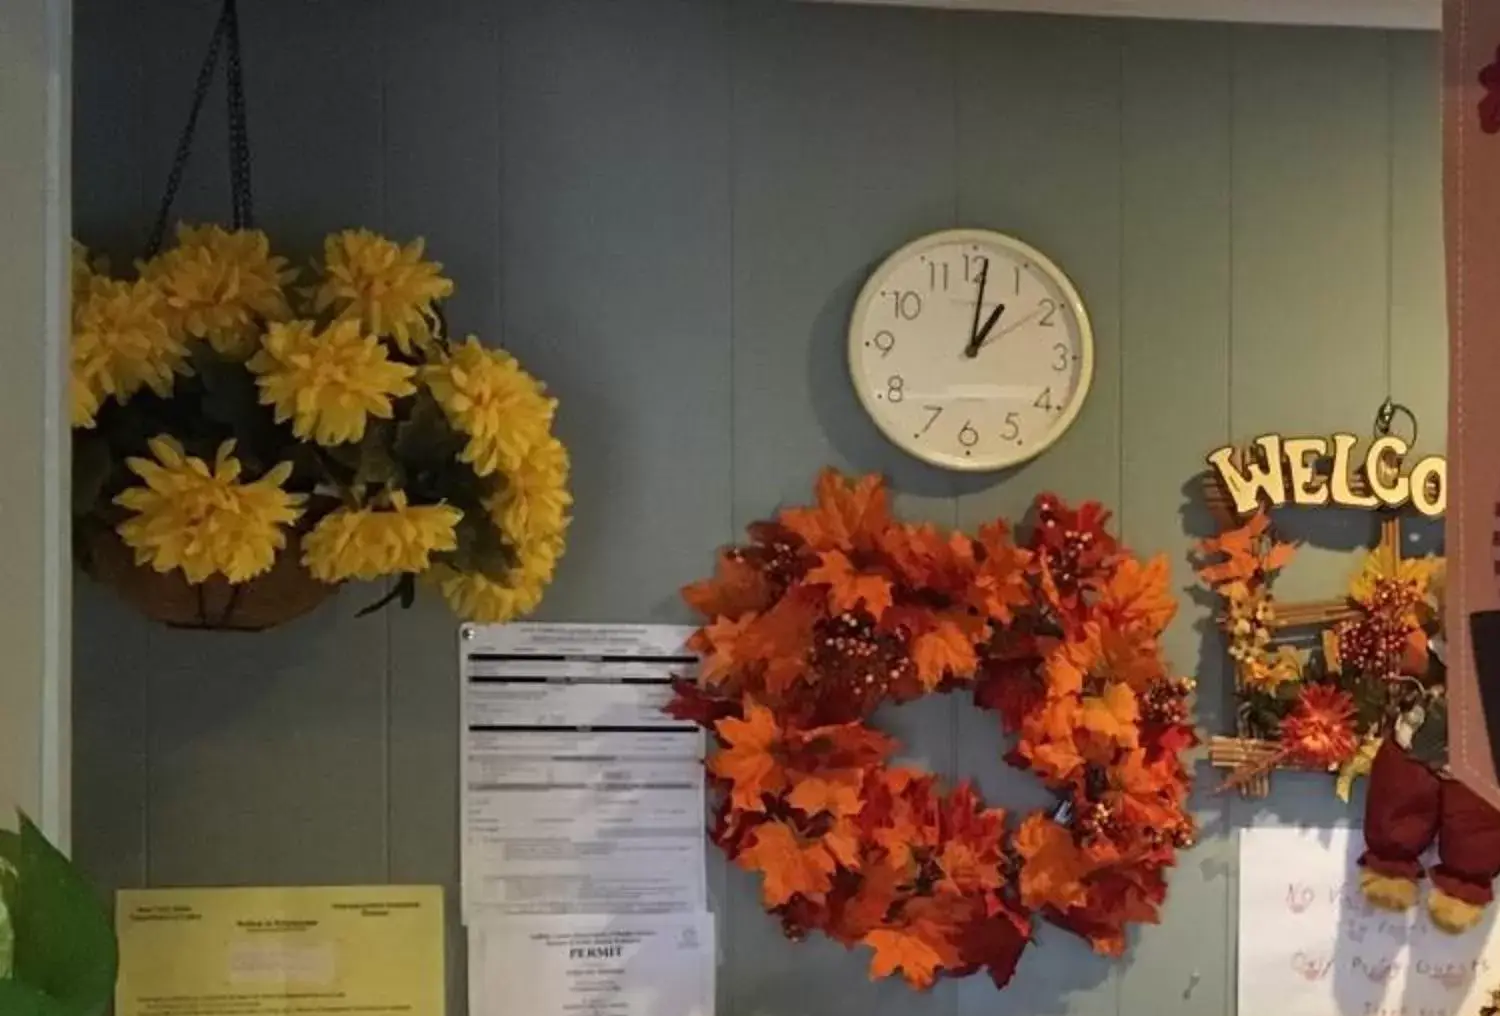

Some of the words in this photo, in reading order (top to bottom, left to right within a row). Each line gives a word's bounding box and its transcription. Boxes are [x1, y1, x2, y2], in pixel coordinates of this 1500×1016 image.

[929, 262, 949, 291] 11
[963, 253, 990, 285] 12
[1012, 266, 1021, 296] 1
[892, 290, 922, 320] 10
[1037, 298, 1056, 327] 2
[874, 330, 895, 359] 9
[1051, 342, 1068, 372] 3
[886, 374, 904, 403] 8
[1032, 386, 1053, 413] 4
[922, 404, 944, 433] 7
[957, 419, 979, 447] 6
[999, 412, 1020, 441] 5
[569, 946, 622, 958] PERMIT
